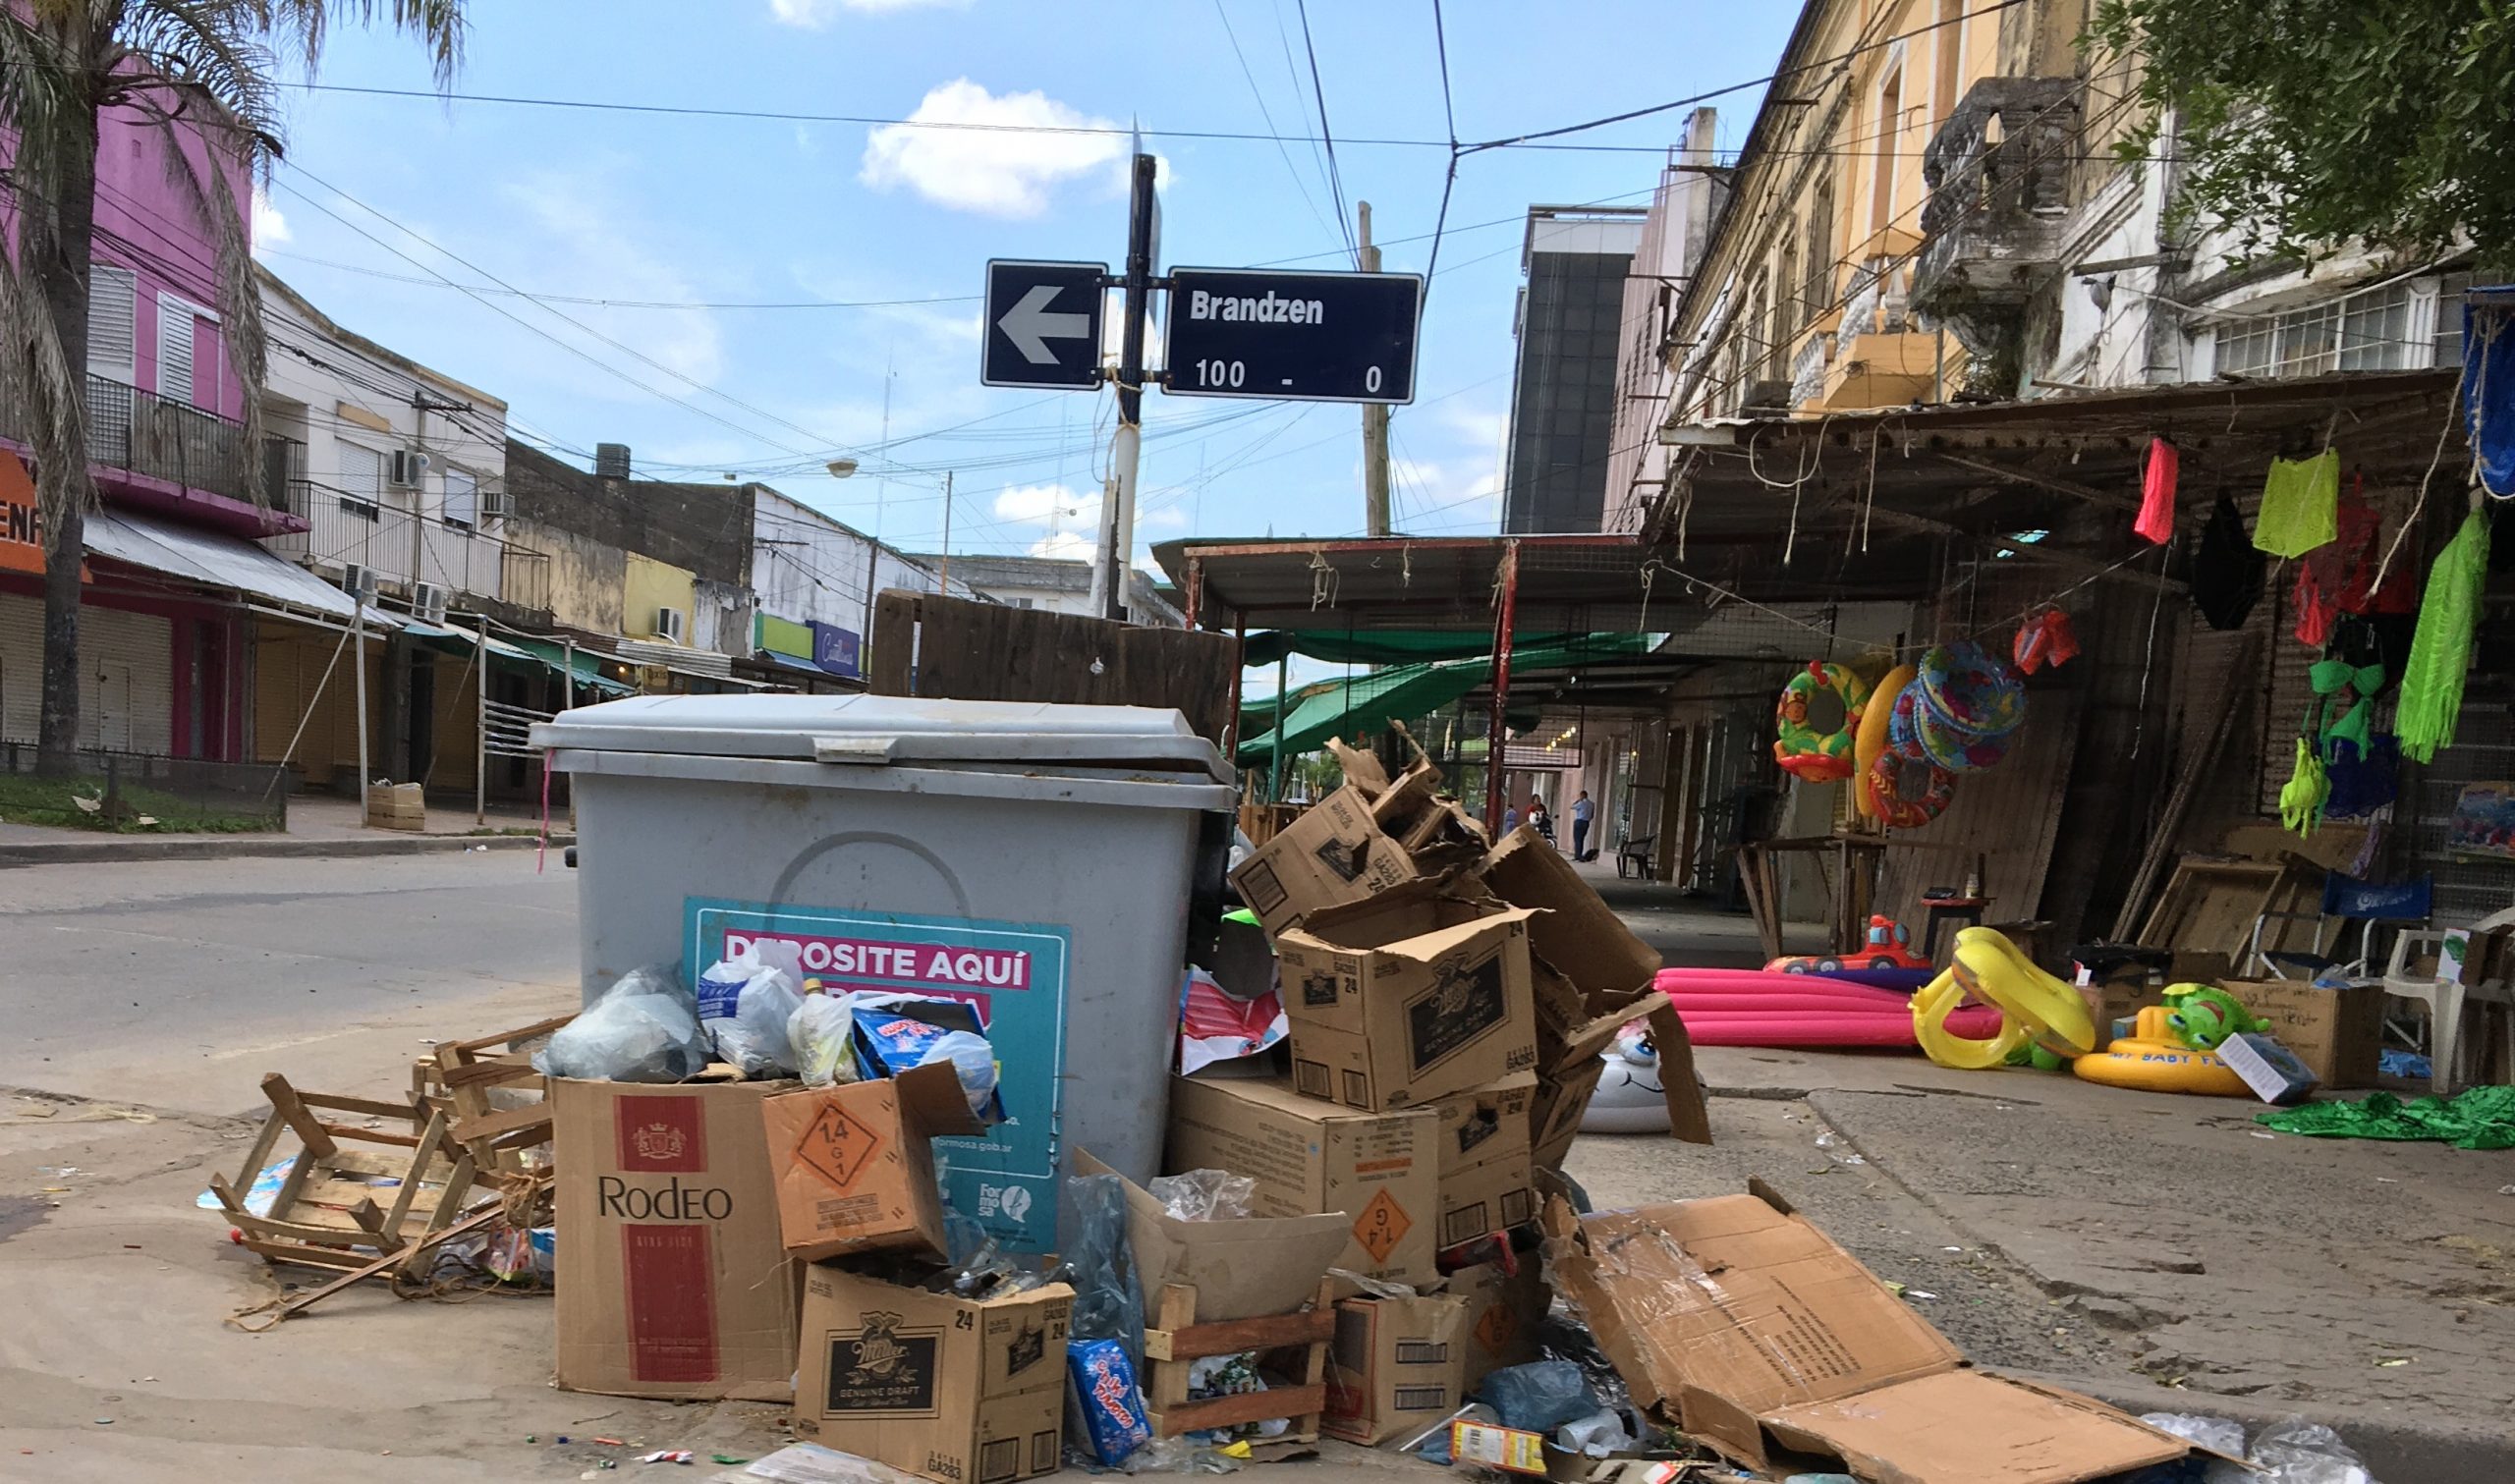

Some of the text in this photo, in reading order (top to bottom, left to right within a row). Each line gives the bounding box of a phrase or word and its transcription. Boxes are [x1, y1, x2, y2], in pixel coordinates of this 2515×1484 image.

[1191, 291, 1323, 324] Brandzen
[1197, 359, 1245, 387] 100
[1366, 366, 1381, 393] 0
[925, 950, 1028, 987] AQUÍ
[2142, 1053, 2189, 1064] BABY
[819, 1119, 849, 1144] 1.4
[831, 1146, 843, 1160] G
[980, 1182, 1002, 1198] For
[1376, 1208, 1388, 1226] G
[1368, 1227, 1393, 1247] 1.4
[955, 1309, 974, 1331] 24
[1052, 1323, 1065, 1340] 24
[851, 1342, 910, 1369] Miller
[839, 1386, 921, 1398] GENUINE DRAFT
